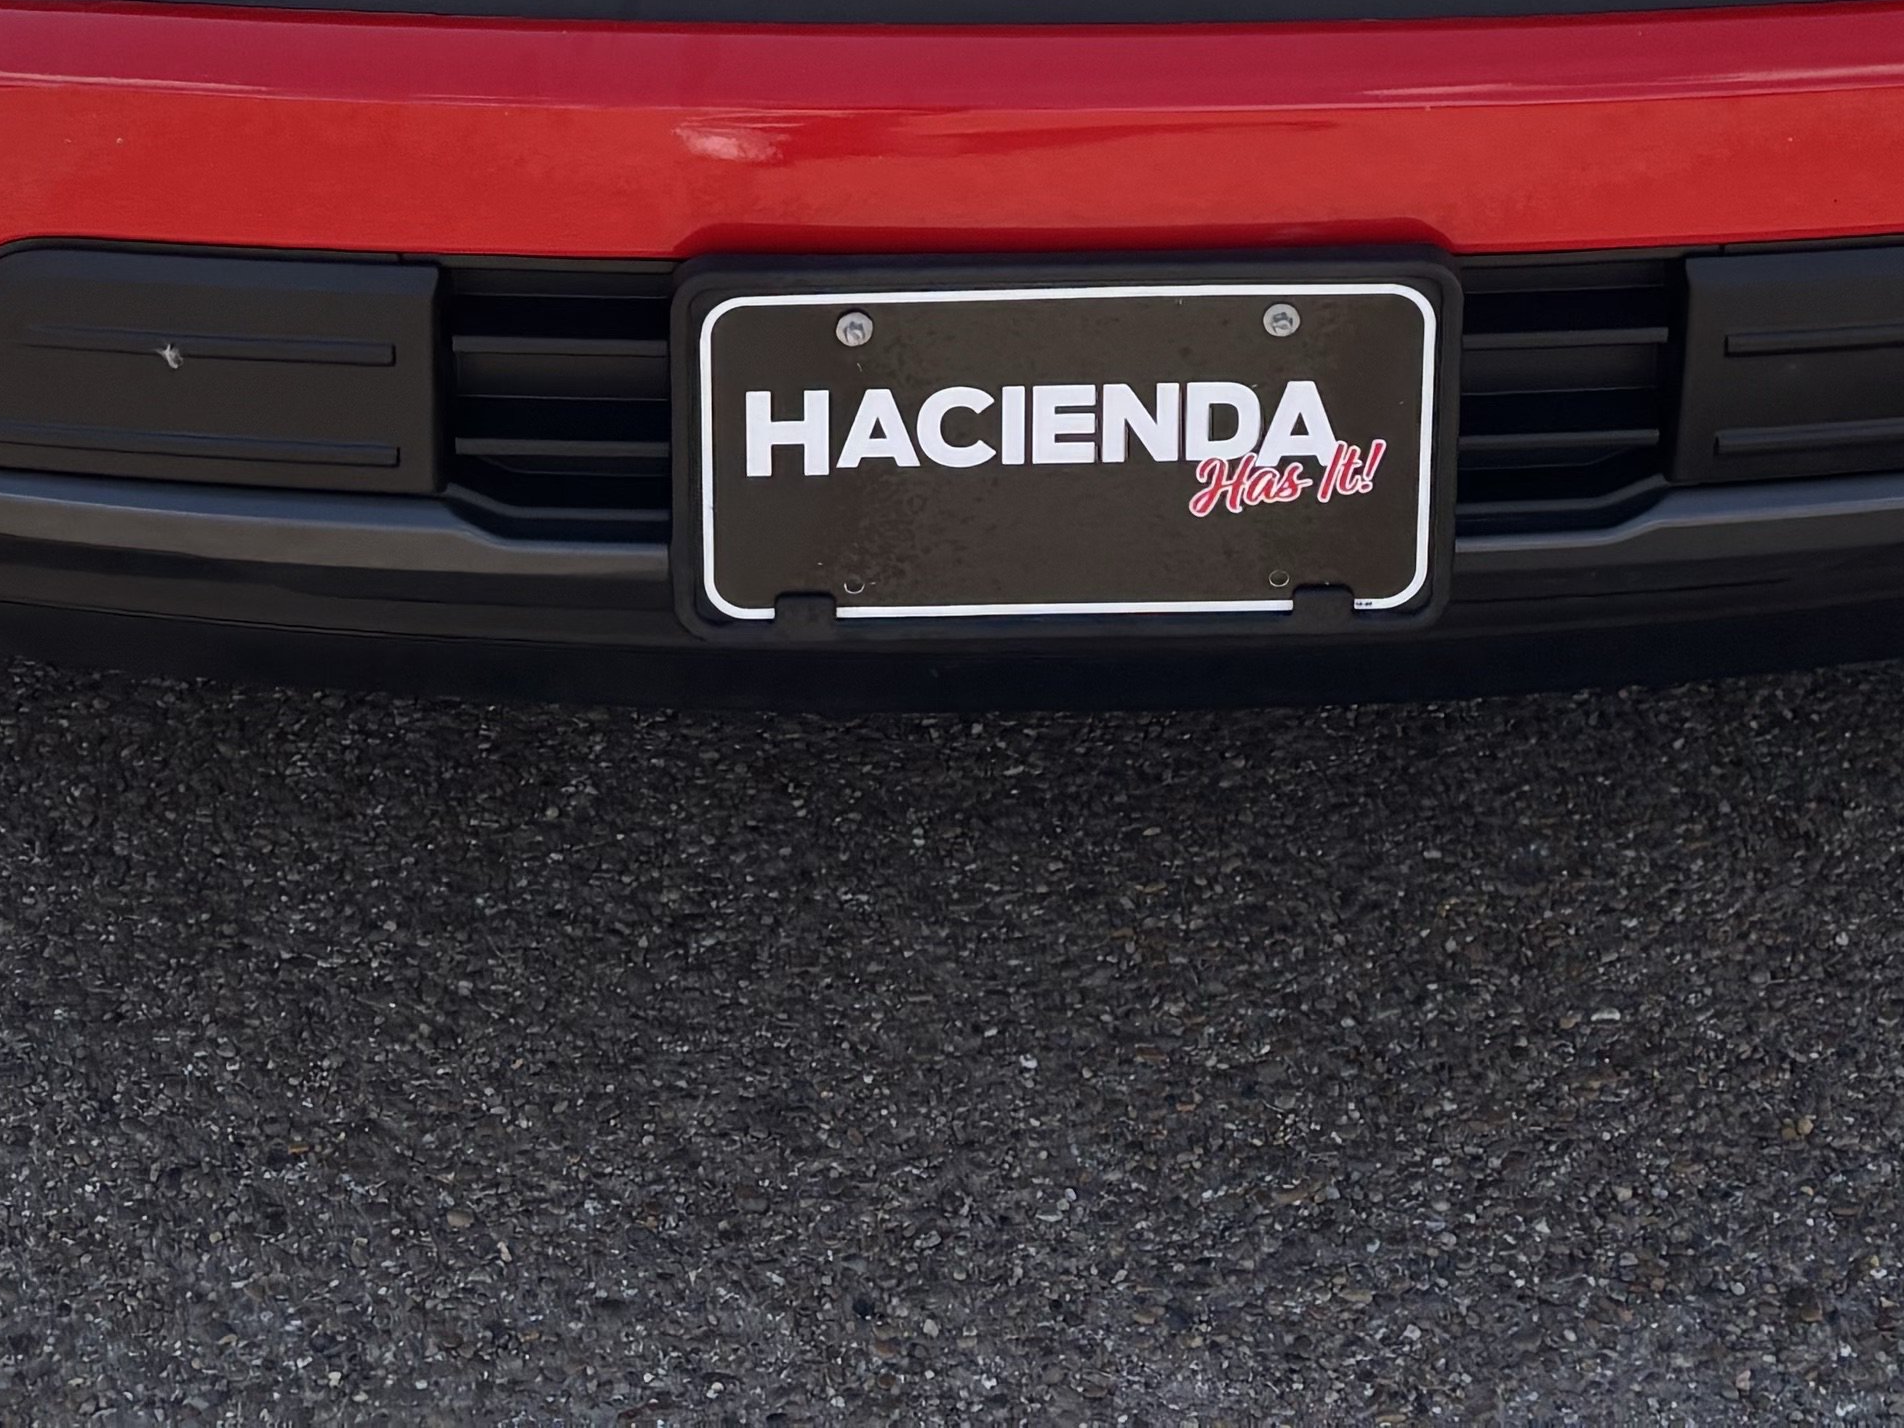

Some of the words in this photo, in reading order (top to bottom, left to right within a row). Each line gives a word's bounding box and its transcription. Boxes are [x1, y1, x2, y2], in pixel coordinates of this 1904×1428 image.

[744, 380, 1332, 478] HACIENDA
[1189, 452, 1312, 517] Has
[1317, 439, 1386, 503] It!
